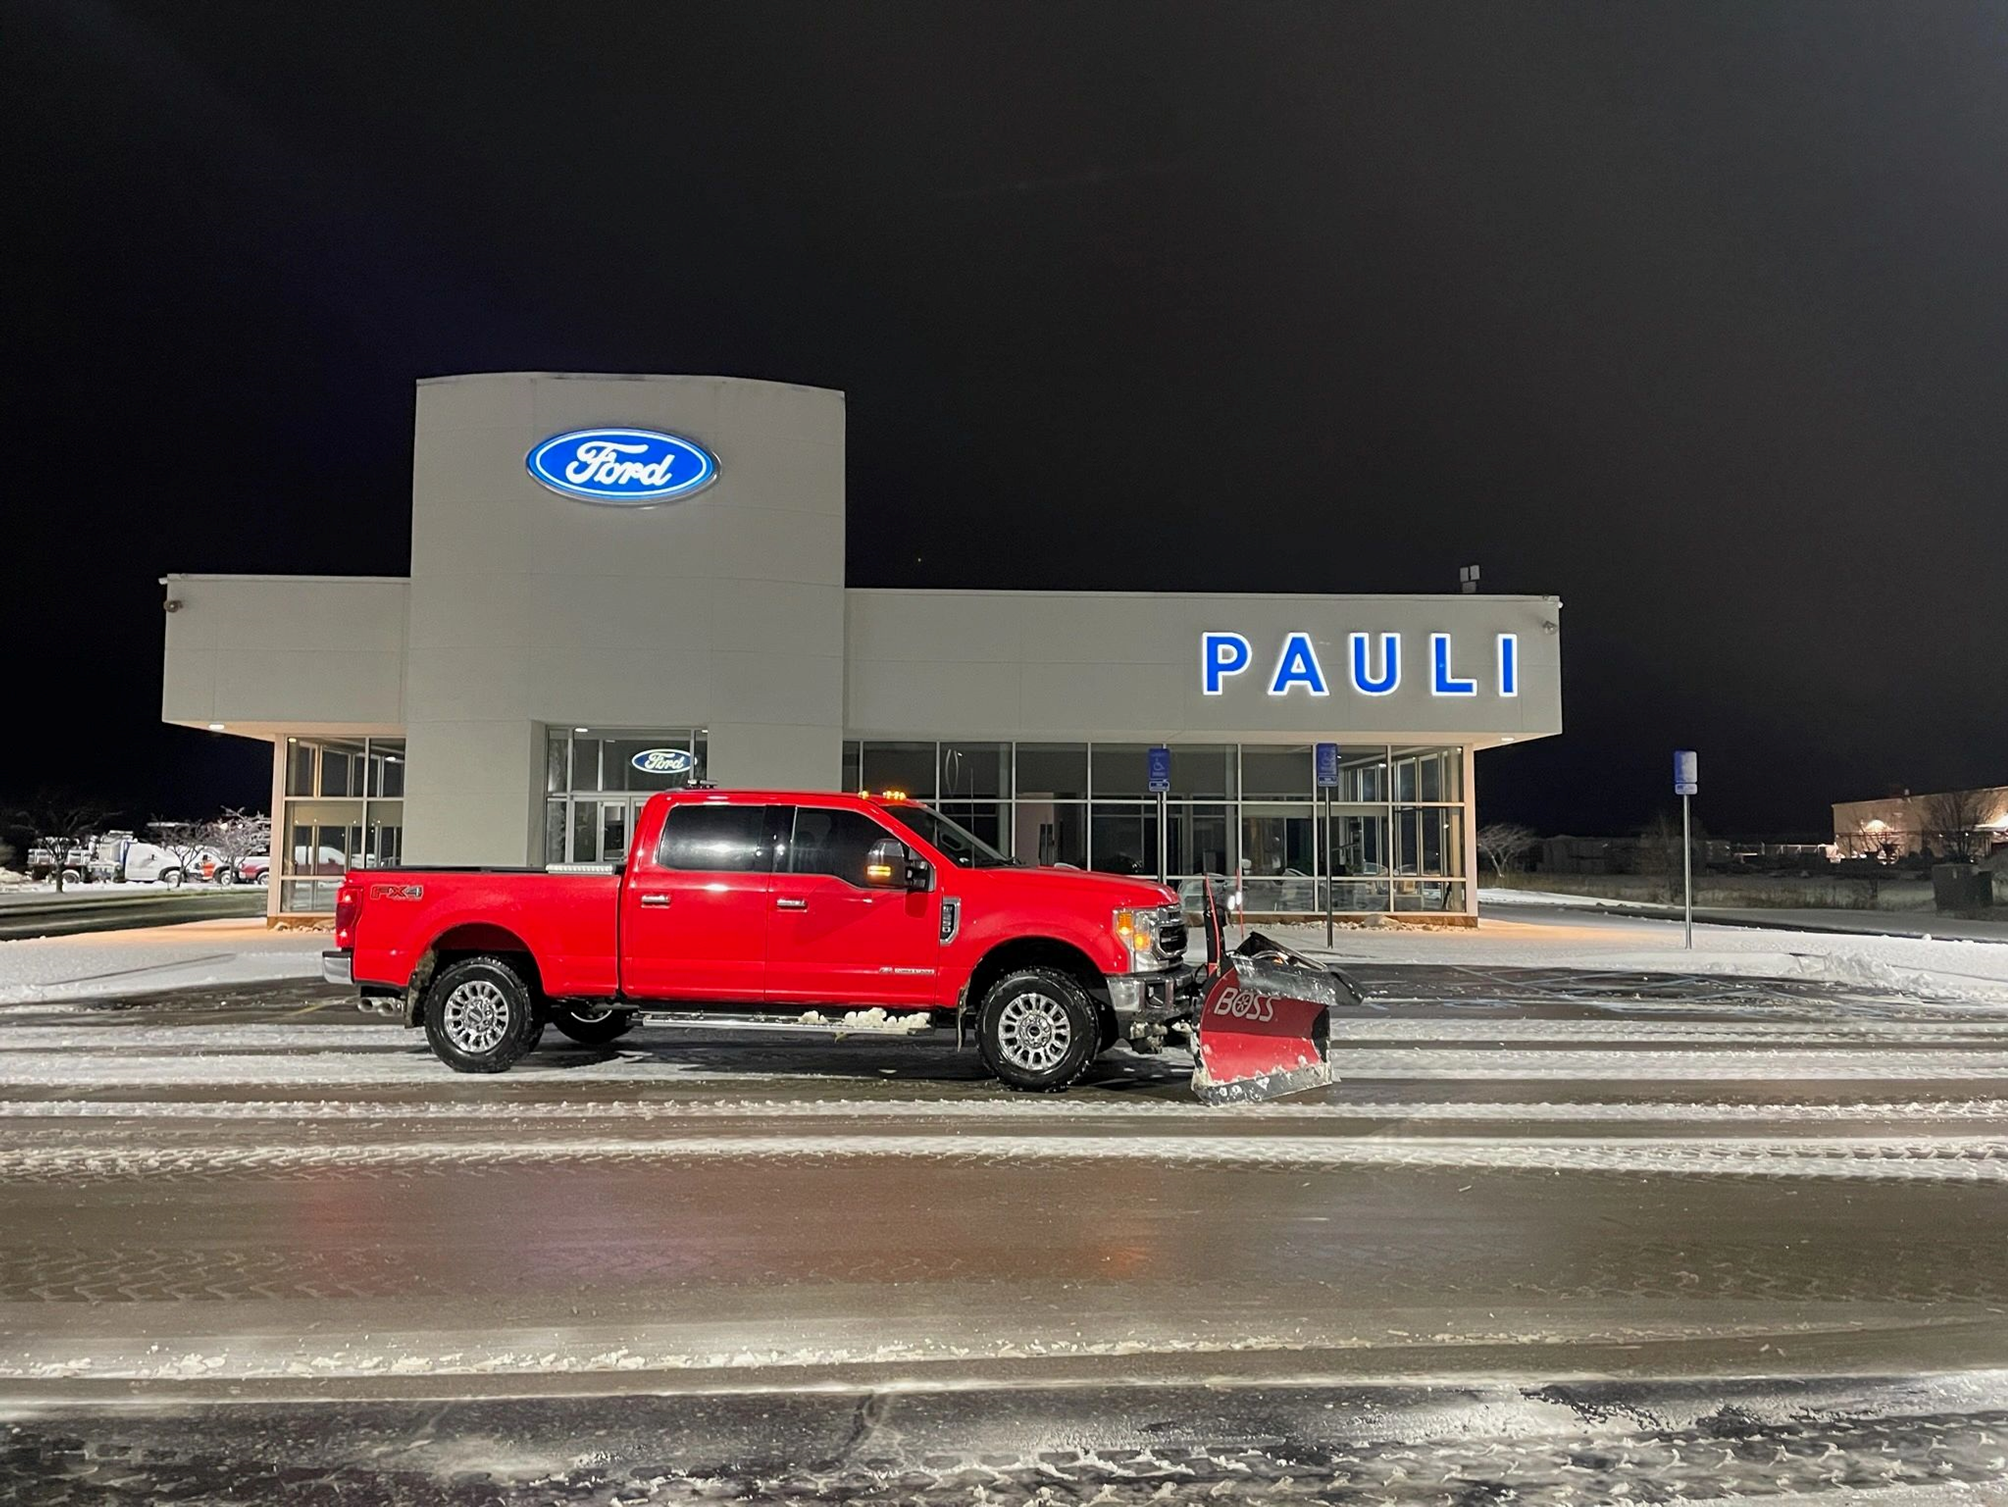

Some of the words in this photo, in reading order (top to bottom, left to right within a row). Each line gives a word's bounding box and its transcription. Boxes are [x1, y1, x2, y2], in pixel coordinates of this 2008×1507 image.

[565, 441, 676, 486] Ford
[1203, 632, 1517, 696] PAULI
[644, 752, 685, 769] Ford
[369, 884, 424, 900] FX4
[1213, 987, 1282, 1022] BOSS
